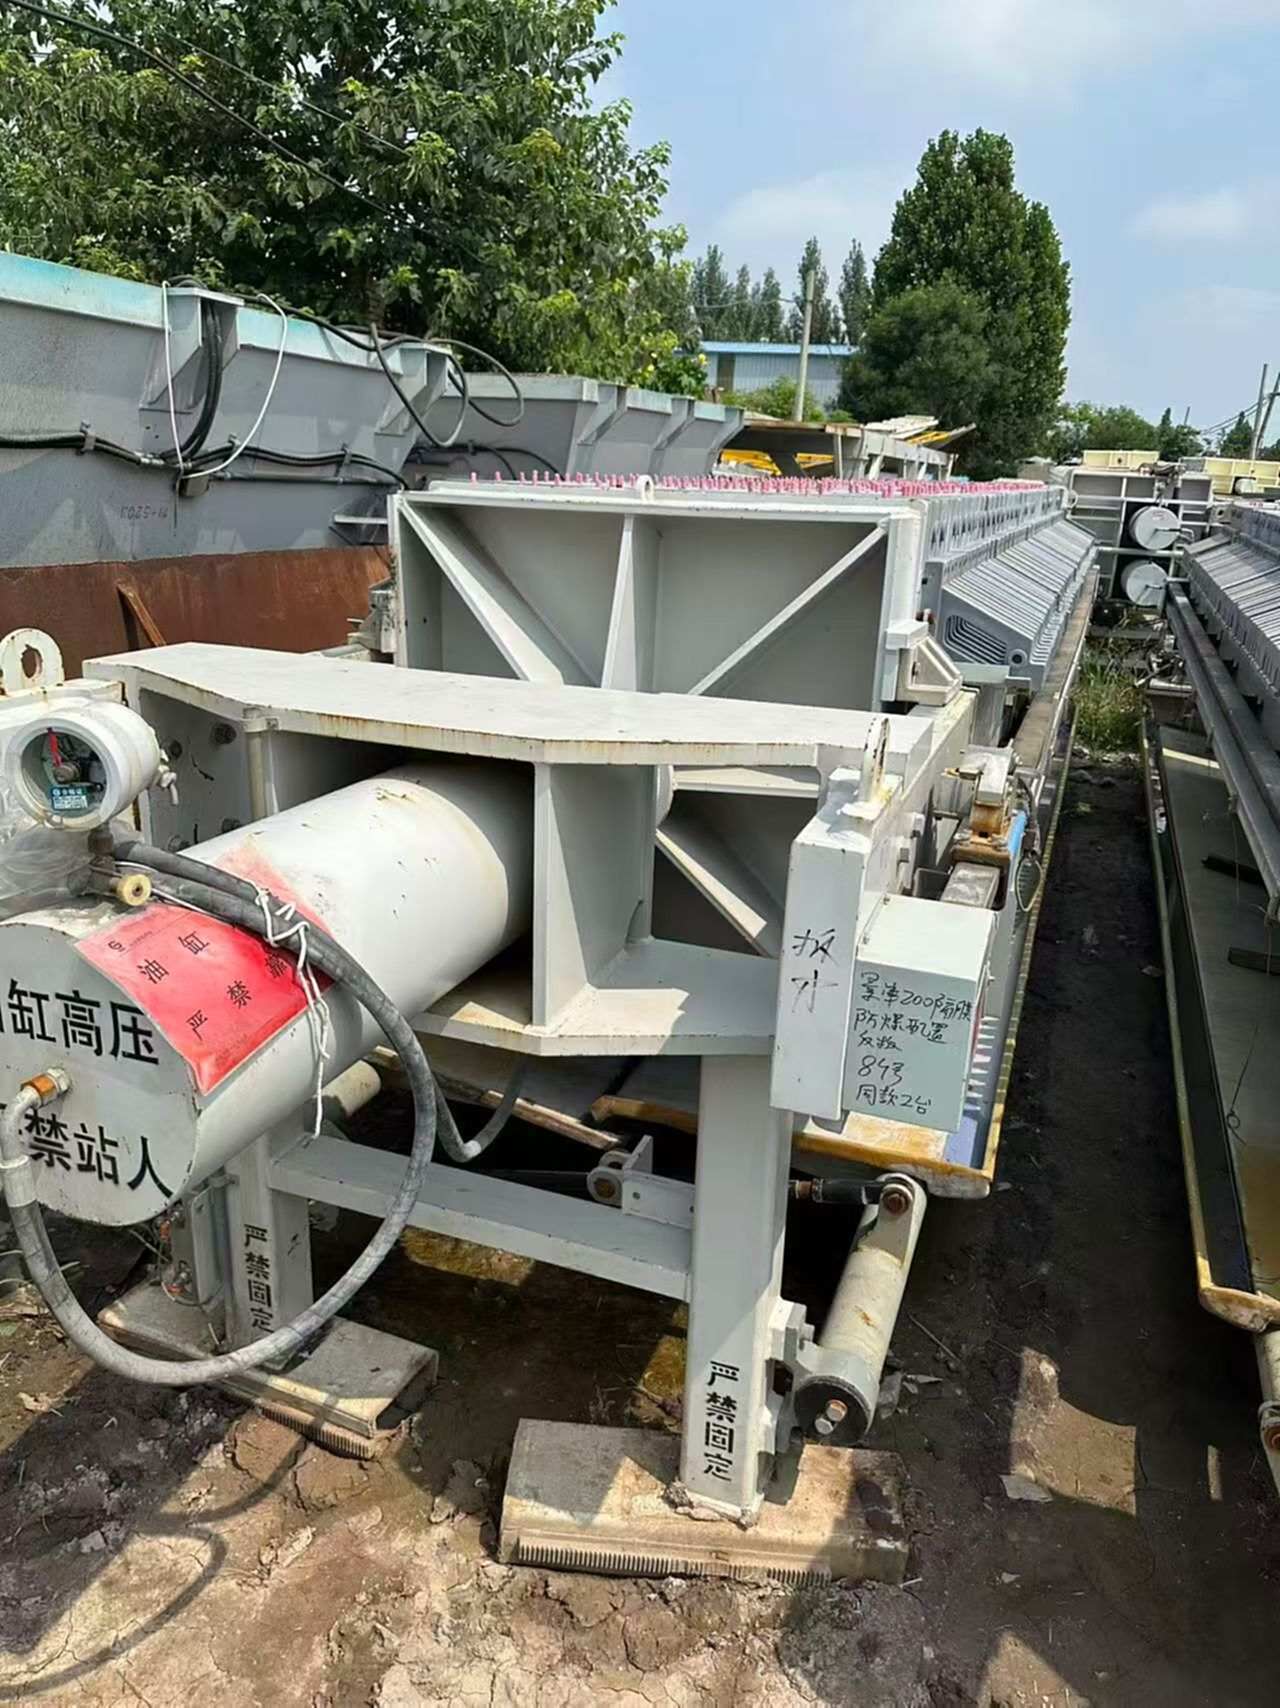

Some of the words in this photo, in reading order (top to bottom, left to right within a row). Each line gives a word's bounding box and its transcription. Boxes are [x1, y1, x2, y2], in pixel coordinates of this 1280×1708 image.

[0, 978, 160, 1066] 缸高压
[855, 1082, 932, 1115] 同款2台
[0, 1102, 175, 1199] 禁站人
[243, 1223, 275, 1334] 严禁固定
[703, 1360, 740, 1482] 严禁固定
